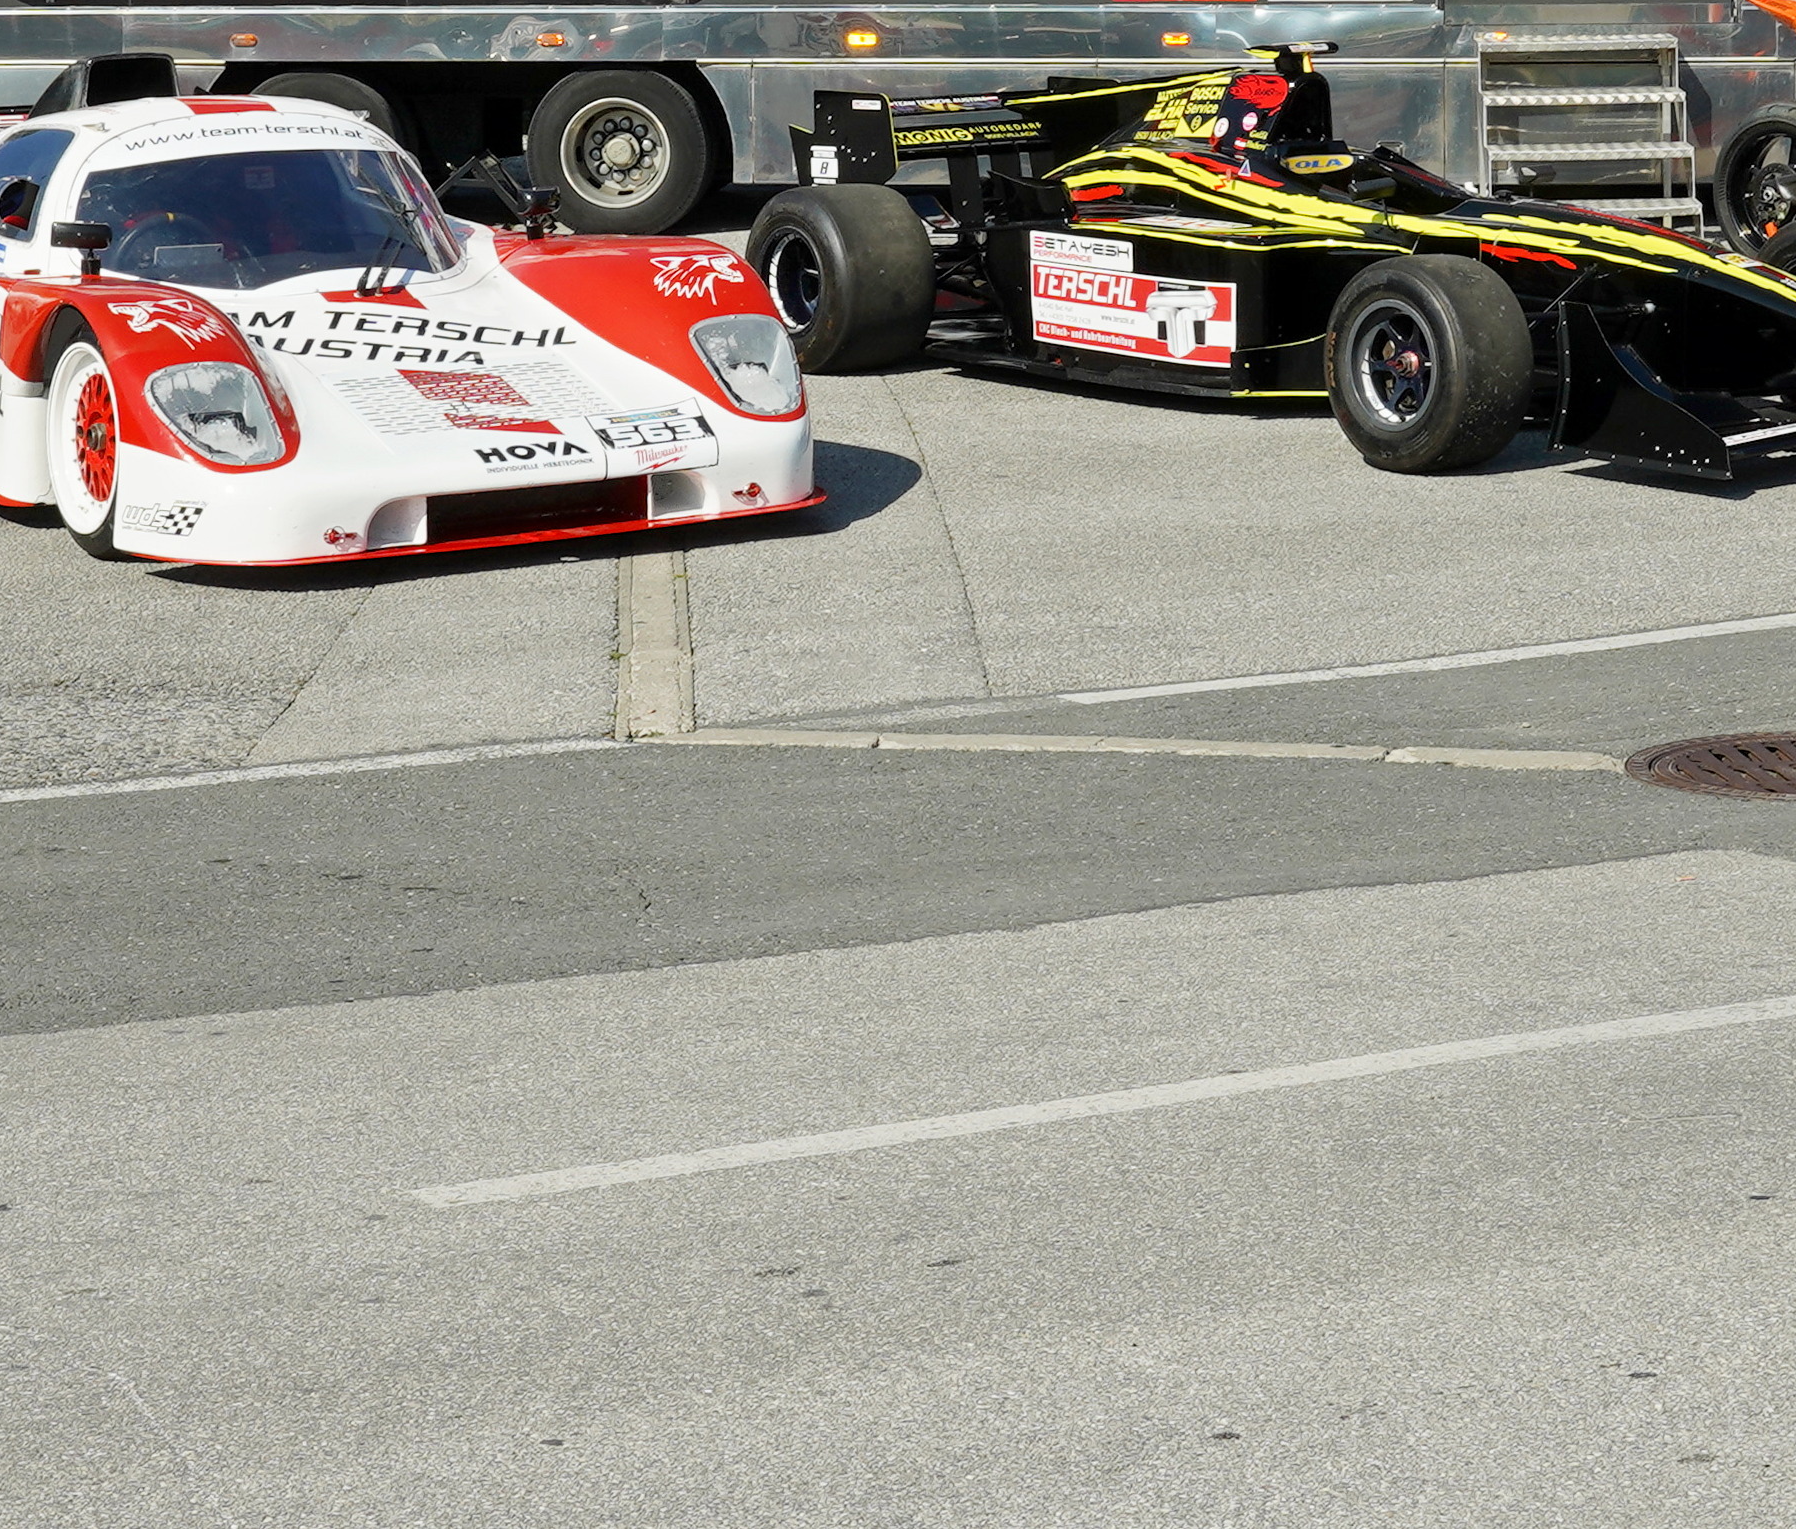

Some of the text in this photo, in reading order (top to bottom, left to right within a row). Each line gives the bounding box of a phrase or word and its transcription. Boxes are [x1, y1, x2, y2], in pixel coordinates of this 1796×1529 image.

[1190, 86, 1226, 101] BOSCH
[1185, 101, 1219, 115] Service
[125, 123, 364, 151] www.team-terschl.at
[1037, 266, 1137, 308] TERSCHL
[324, 311, 578, 347] TERSCHL
[615, 419, 702, 447] 563
[473, 440, 589, 464] HOVA
[122, 503, 170, 526] wds
